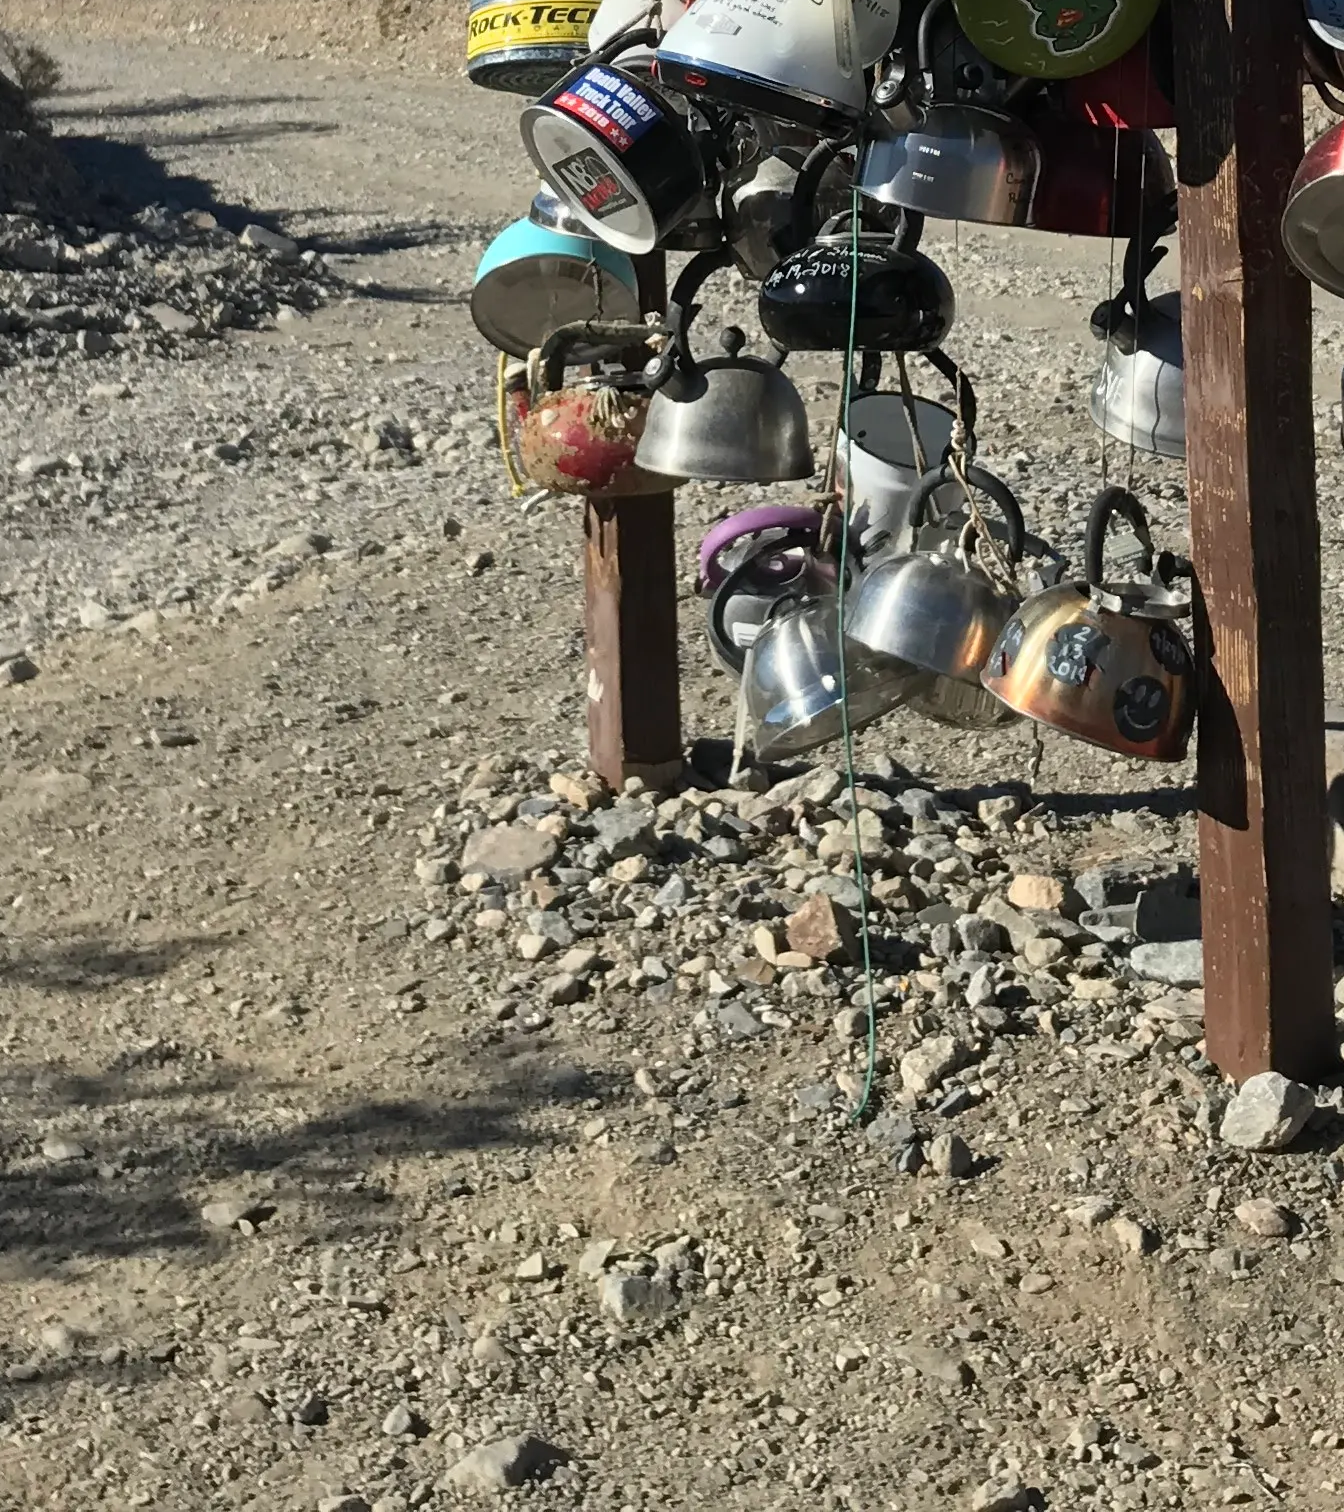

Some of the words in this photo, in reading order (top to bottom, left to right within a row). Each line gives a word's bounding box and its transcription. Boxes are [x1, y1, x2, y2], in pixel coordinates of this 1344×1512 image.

[584, 66, 621, 93] Death
[615, 83, 657, 123] Valley
[605, 99, 639, 131] Tour
